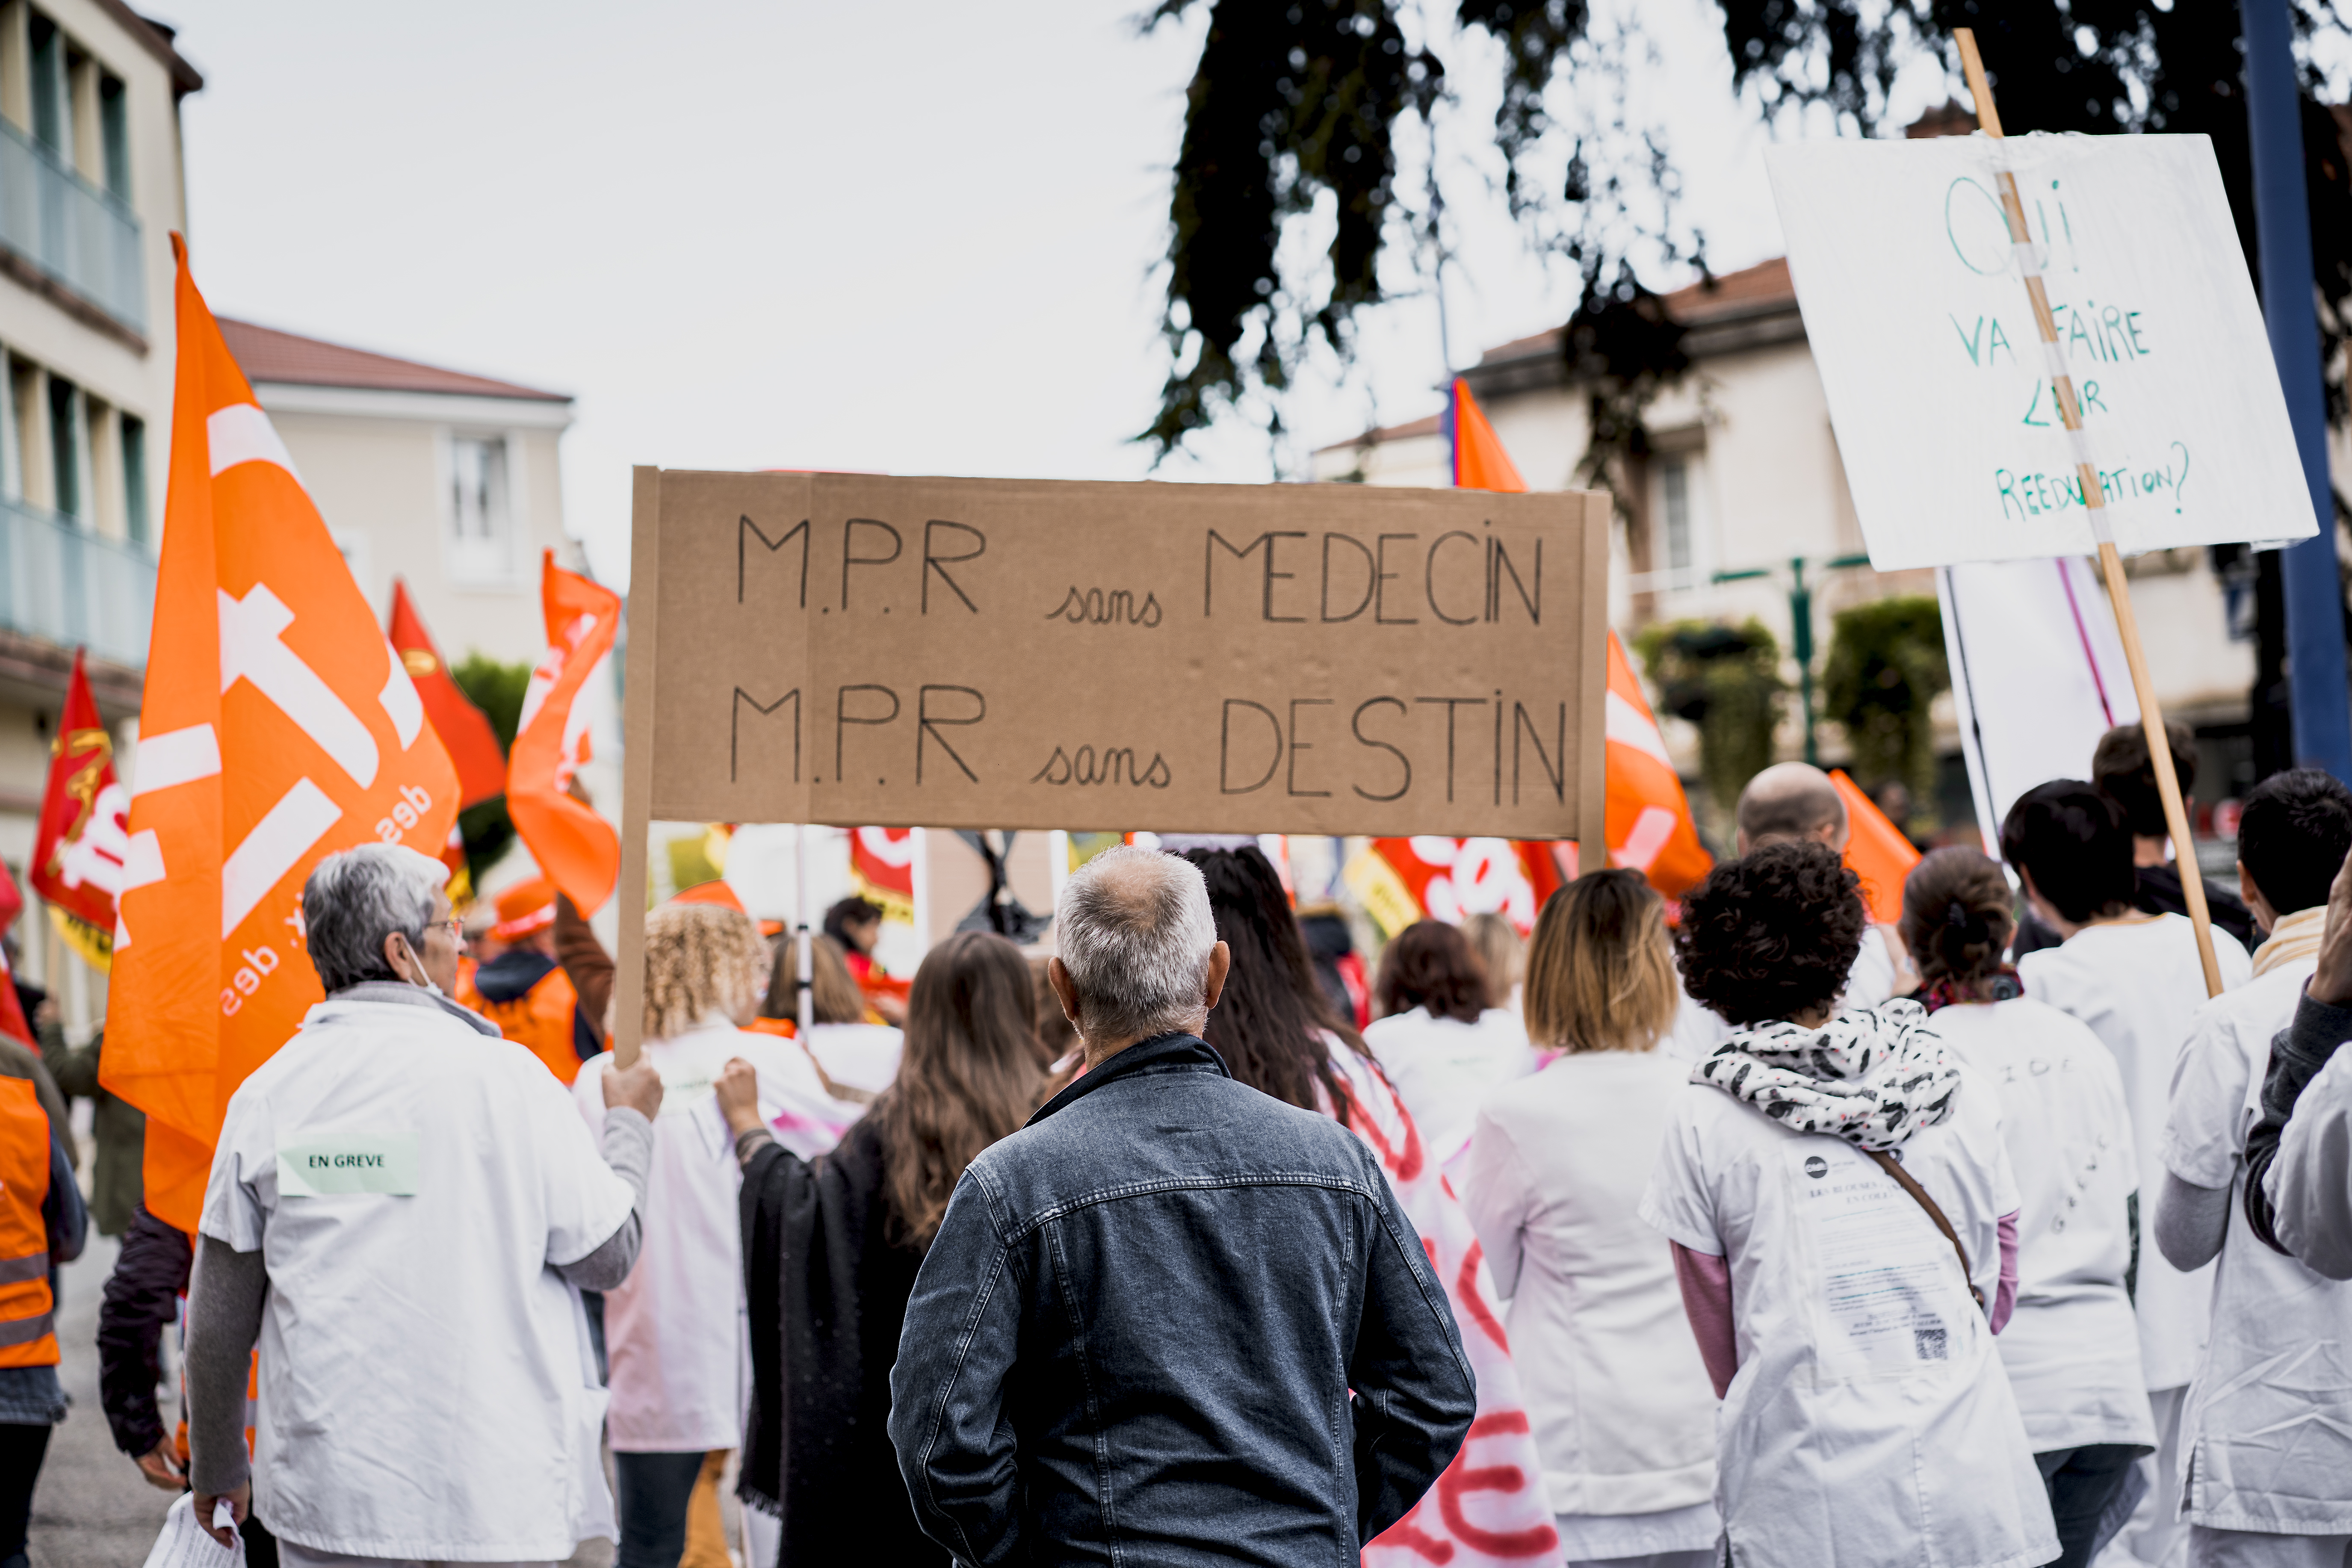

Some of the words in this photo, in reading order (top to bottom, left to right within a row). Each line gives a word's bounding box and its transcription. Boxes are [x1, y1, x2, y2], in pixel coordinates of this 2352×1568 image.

[1948, 313, 2018, 367] VA
[1995, 441, 2189, 522] REEDUATION?
[737, 514, 987, 615] M.P.R
[1045, 585, 1163, 629] sans
[730, 683, 987, 787] M.P.R
[1030, 743, 1172, 788] sans
[309, 1154, 329, 1168] EN
[334, 1154, 385, 1168] GREVE
